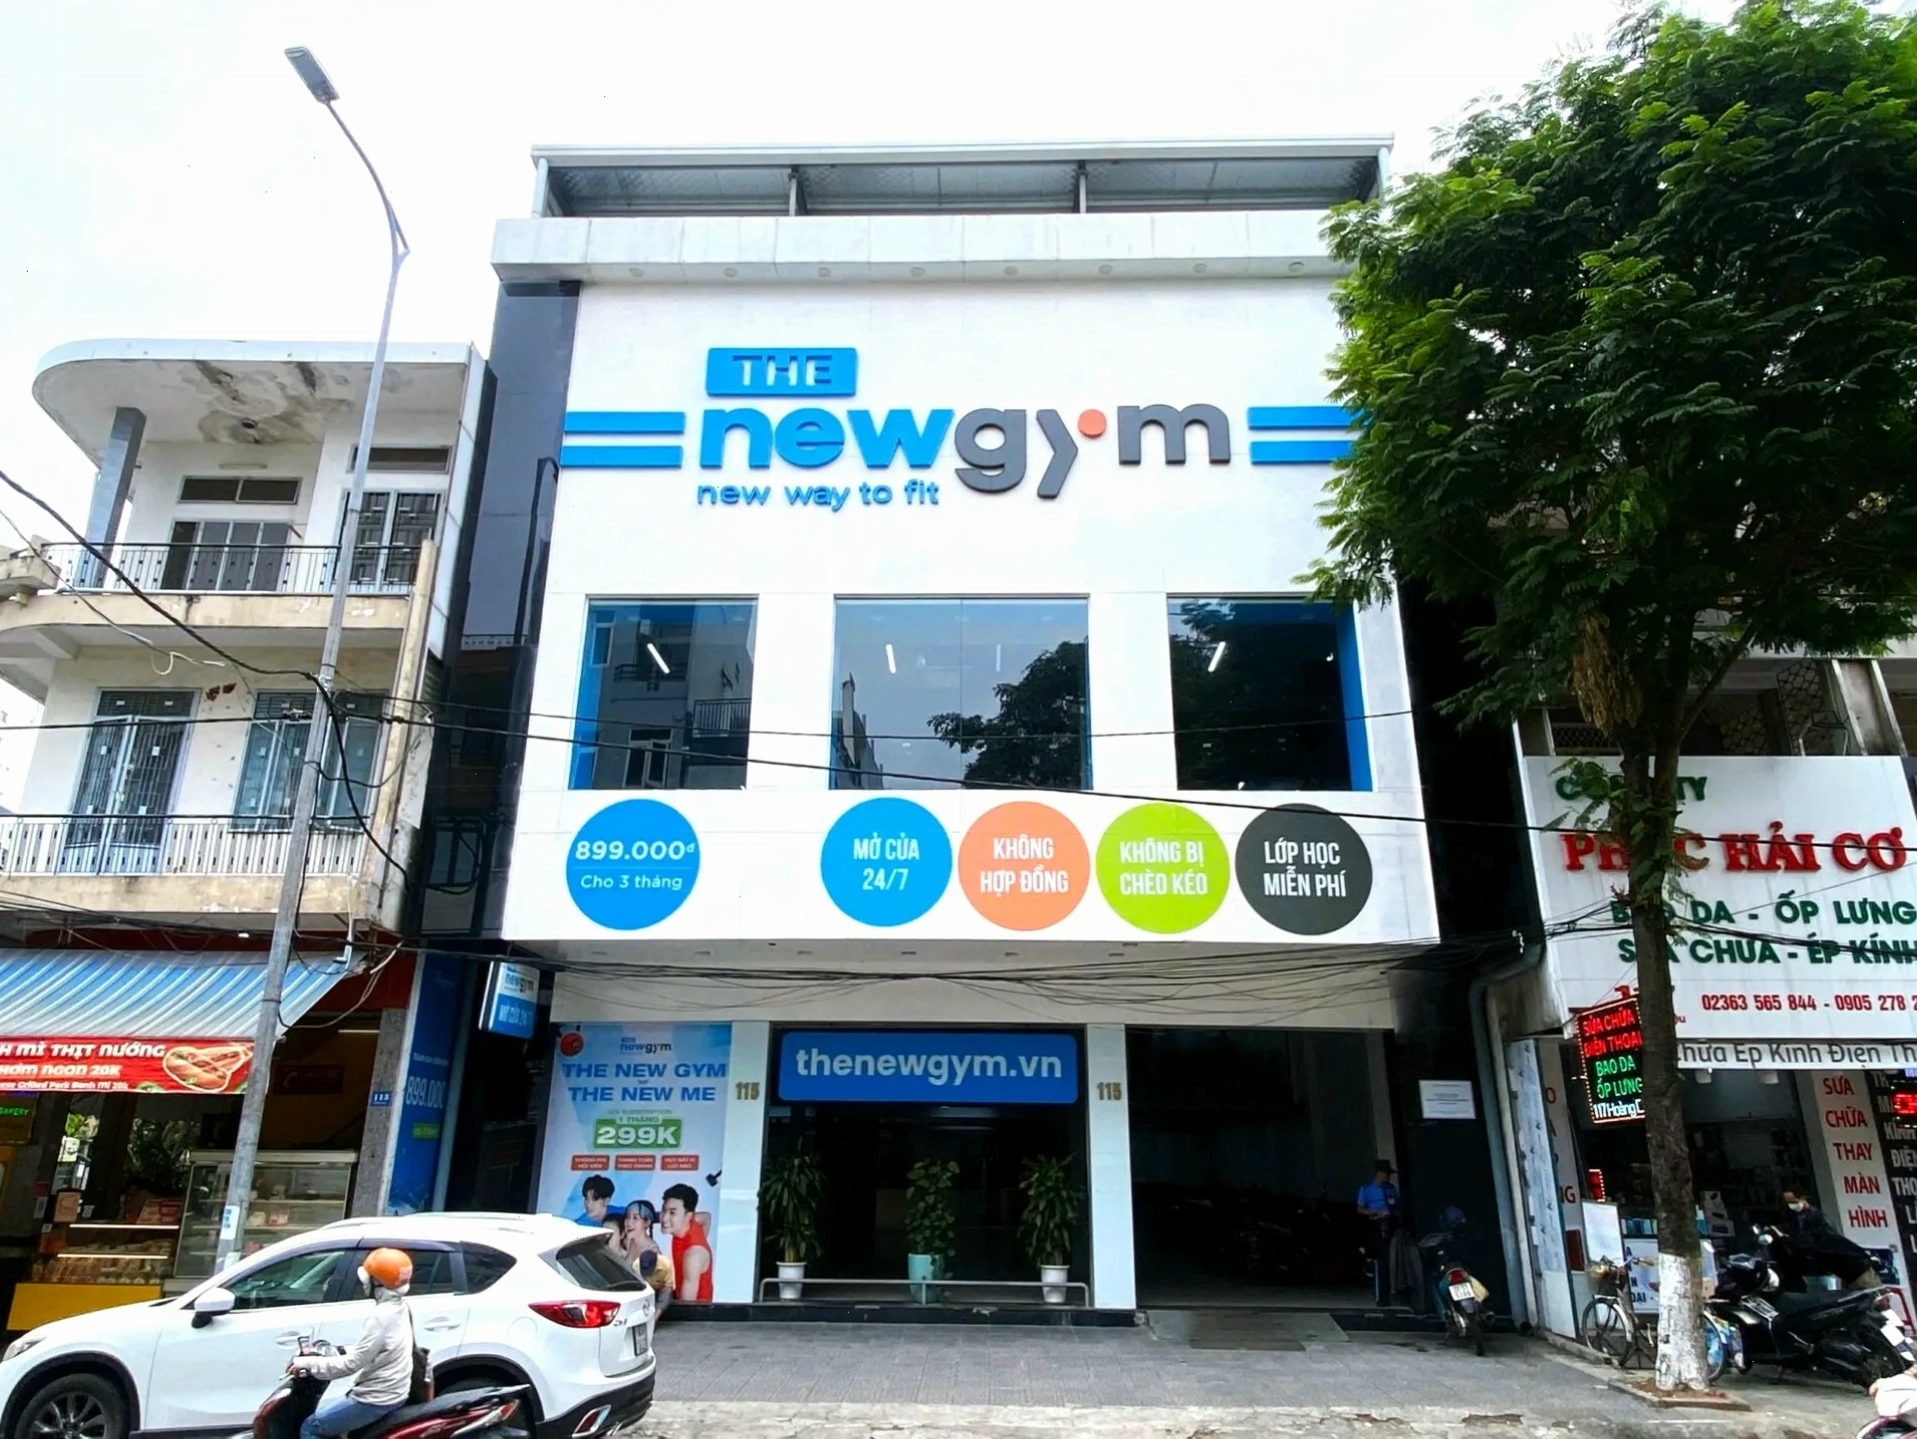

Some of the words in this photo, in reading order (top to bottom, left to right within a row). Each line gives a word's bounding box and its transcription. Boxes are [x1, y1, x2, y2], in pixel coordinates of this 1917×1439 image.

[732, 354, 832, 387] THE
[697, 483, 771, 506] new
[784, 484, 850, 512] way
[859, 481, 893, 505] to
[904, 478, 940, 505] fit
[853, 831, 881, 862] MỞ
[884, 831, 920, 862] CỬA
[993, 834, 1054, 860] KHÔNG
[1120, 838, 1181, 864] KHÔNG
[1185, 841, 1205, 868] BỊ
[1264, 841, 1300, 865] LỚP
[1303, 842, 1341, 869] HỌC
[1719, 820, 1822, 872] HẢI
[1832, 826, 1907, 872] CƠ
[580, 874, 613, 890] Cho
[619, 874, 630, 890] 3
[634, 873, 683, 892] tháng
[862, 868, 909, 891] 24/7
[980, 869, 1015, 898] HỢP
[1019, 864, 1069, 894] ĐỒNG
[1120, 868, 1168, 895] CHÈO
[1172, 869, 1208, 896] KÉO
[1263, 865, 1312, 897] MIỄN
[1315, 871, 1347, 898] PHÍ
[1690, 901, 1736, 924] DA
[1774, 889, 1819, 924] ỐP
[1832, 897, 1917, 924] LƯNG
[1701, 994, 1748, 1011] 02363
[1753, 994, 1783, 1011] 565
[1787, 994, 1817, 1011] 844
[1835, 994, 1873, 1012] 0905
[1878, 994, 1906, 1012] 278
[562, 1063, 608, 1078] THE
[614, 1063, 667, 1078] NEW
[674, 1063, 726, 1078] GYM
[796, 1048, 1063, 1086] thenewgym.vn
[1595, 1058, 1618, 1077] BAO
[1618, 1055, 1637, 1073] DA
[568, 1086, 614, 1101] THE
[621, 1086, 674, 1101] NEW
[681, 1086, 716, 1101] ME
[735, 1081, 761, 1100] 115
[1096, 1082, 1122, 1100] 115
[1593, 1102, 1607, 1119] 117
[1825, 1106, 1868, 1128] CHỮA
[596, 1126, 678, 1145] 299K
[1833, 1142, 1873, 1161] THAY
[1844, 1172, 1881, 1194] MÀN
[1848, 1205, 1888, 1228] HÌNH
